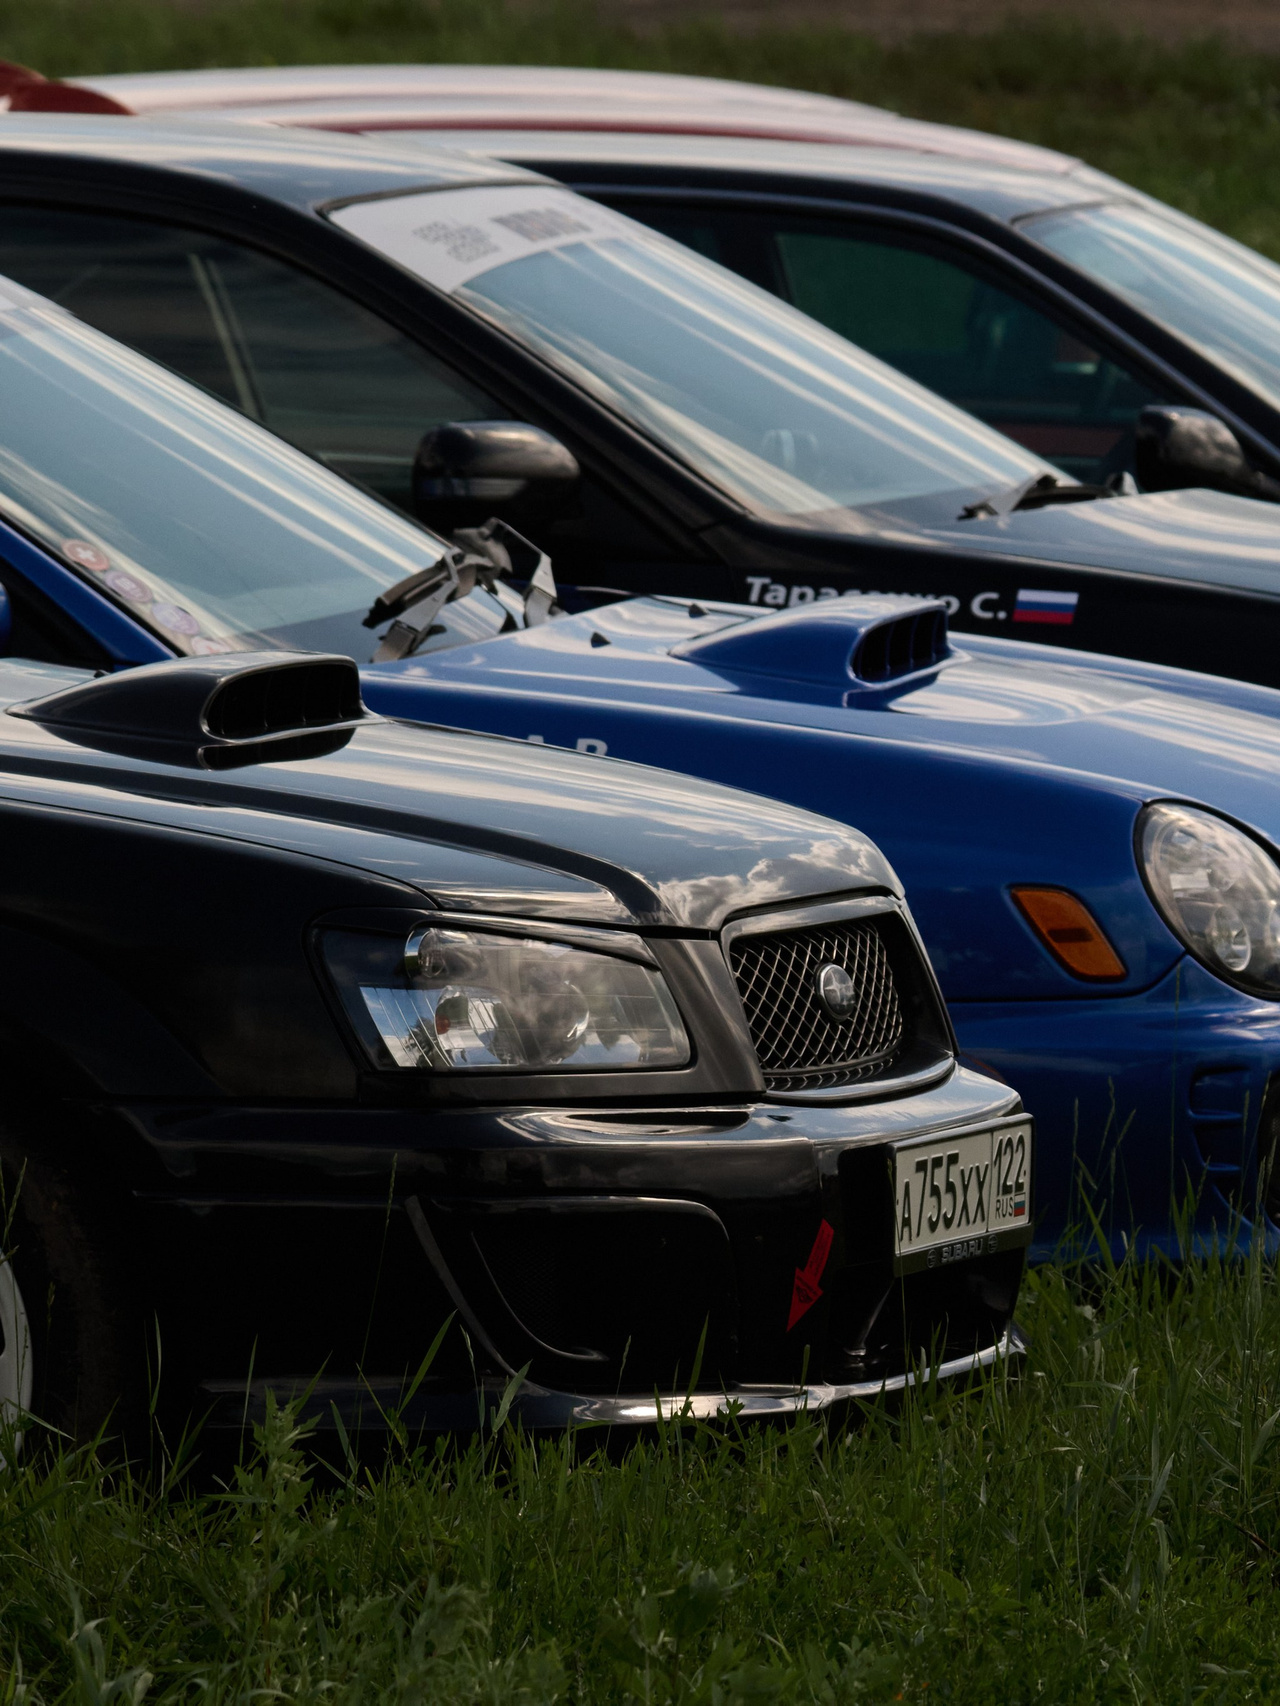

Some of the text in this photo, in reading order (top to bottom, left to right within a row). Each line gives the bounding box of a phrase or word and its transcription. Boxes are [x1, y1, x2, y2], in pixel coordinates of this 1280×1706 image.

[993, 1132, 1026, 1197] 122
[995, 1197, 1014, 1219] RUS
[941, 1238, 984, 1263] SUBARU
